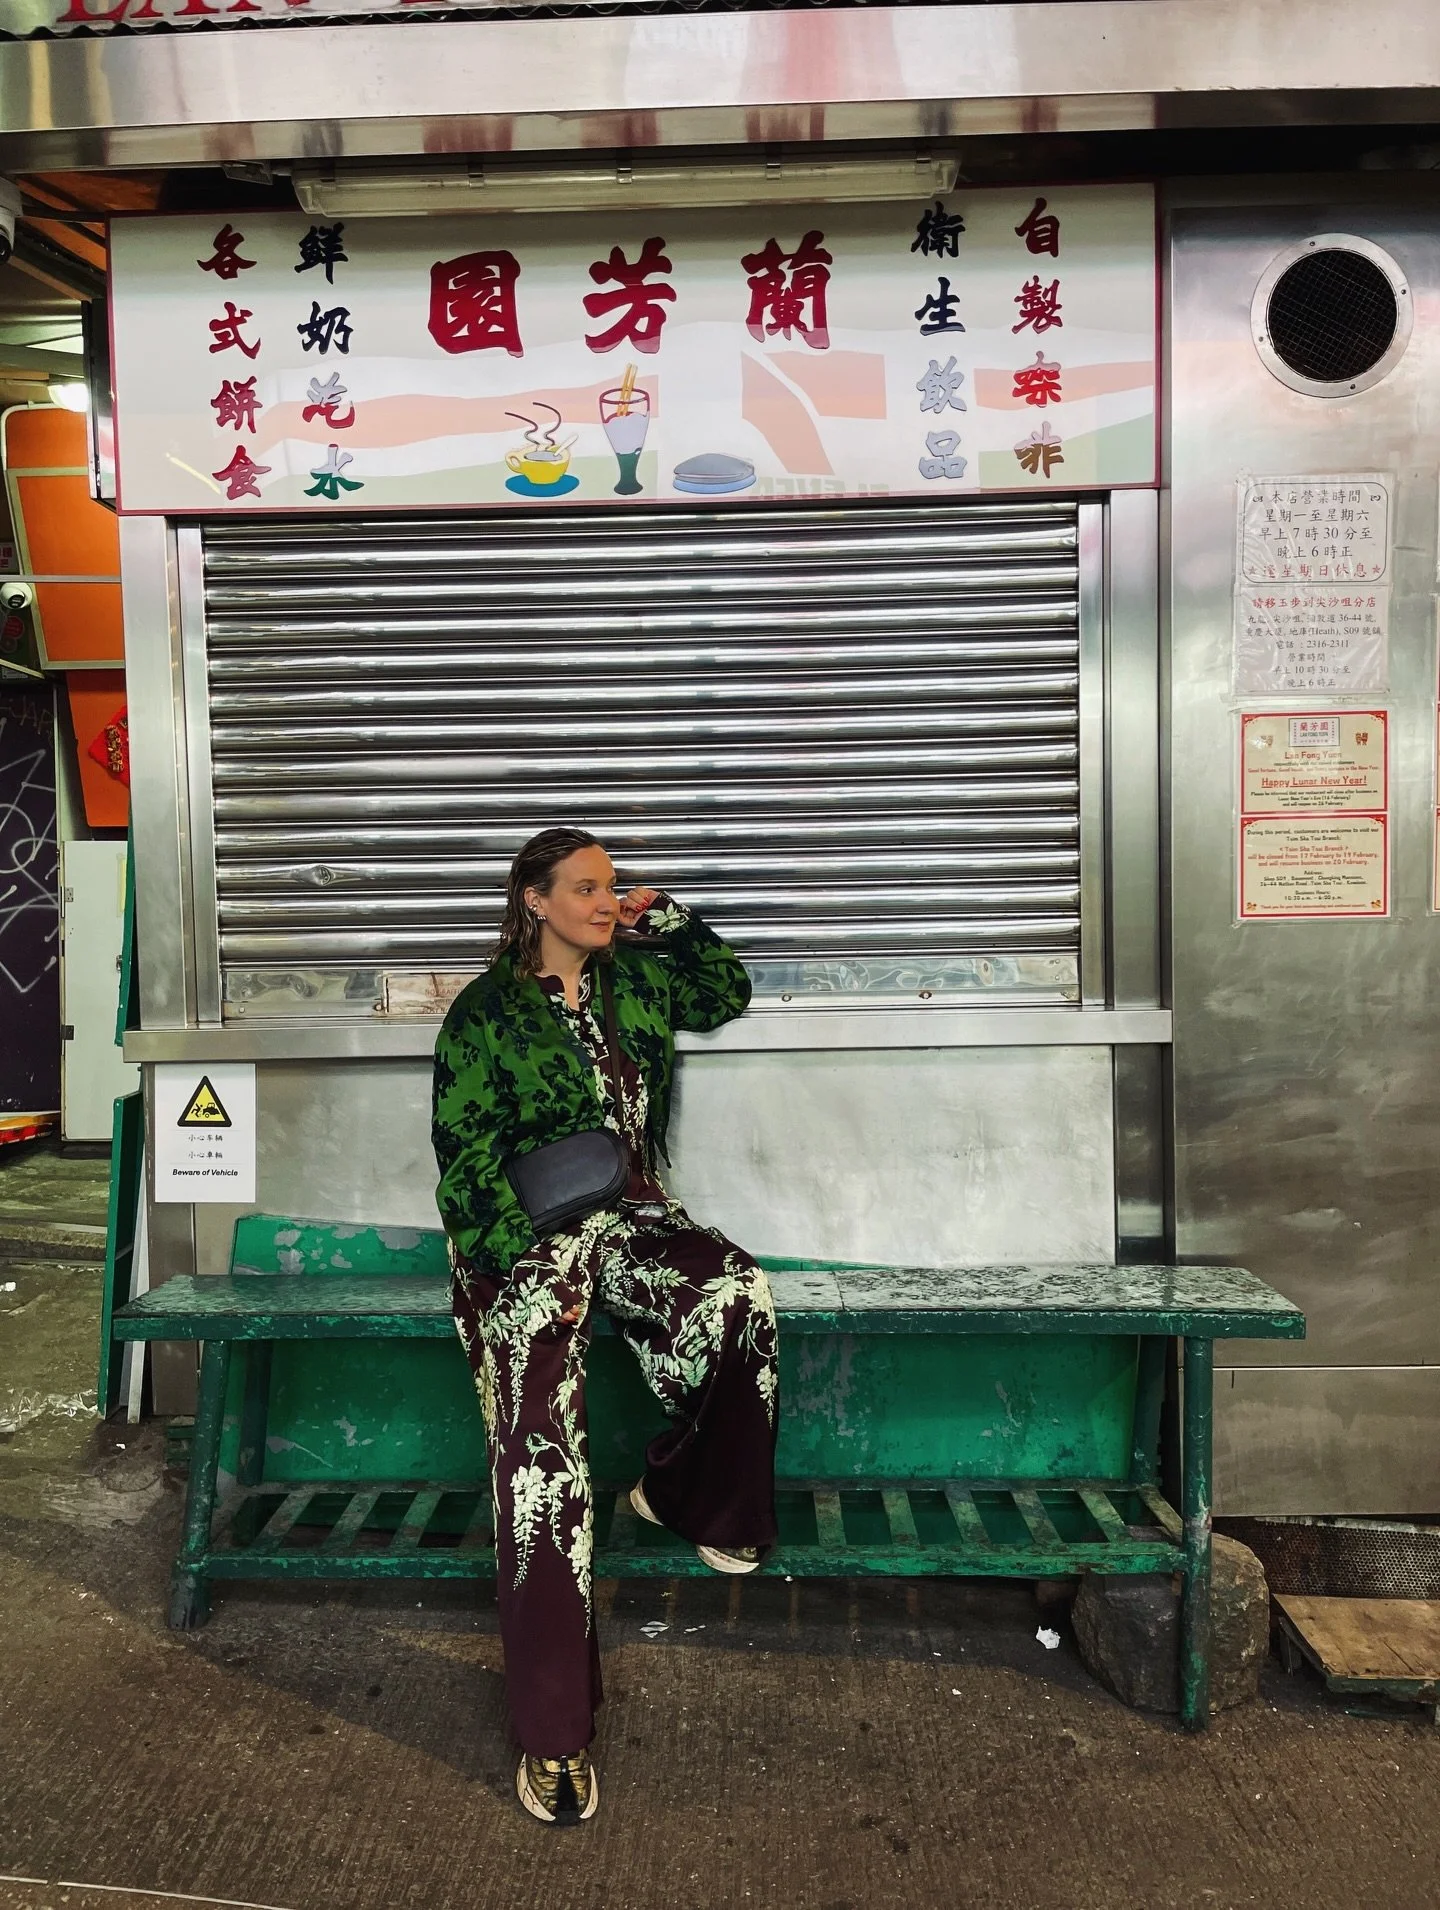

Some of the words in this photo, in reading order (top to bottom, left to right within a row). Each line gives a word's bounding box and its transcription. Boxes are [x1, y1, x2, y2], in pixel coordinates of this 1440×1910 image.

[197, 223, 272, 500] 各式餅食
[294, 221, 364, 500] 鮮奶汽水
[1271, 489, 1361, 504] 本店營業時間
[1263, 509, 1370, 523] 星期一至星期六
[1263, 563, 1367, 578] 逢星期日休息
[1307, 640, 1350, 648] 2316-2311
[1302, 751, 1321, 761] Fong
[1262, 778, 1290, 789] Happy
[1293, 777, 1317, 786] Lunar
[1321, 776, 1341, 785] New
[1343, 775, 1367, 785] Year!
[188, 1134, 224, 1142] 小心车辆
[188, 1151, 224, 1159] 小心車輛
[211, 1169, 239, 1177] Vehicle
